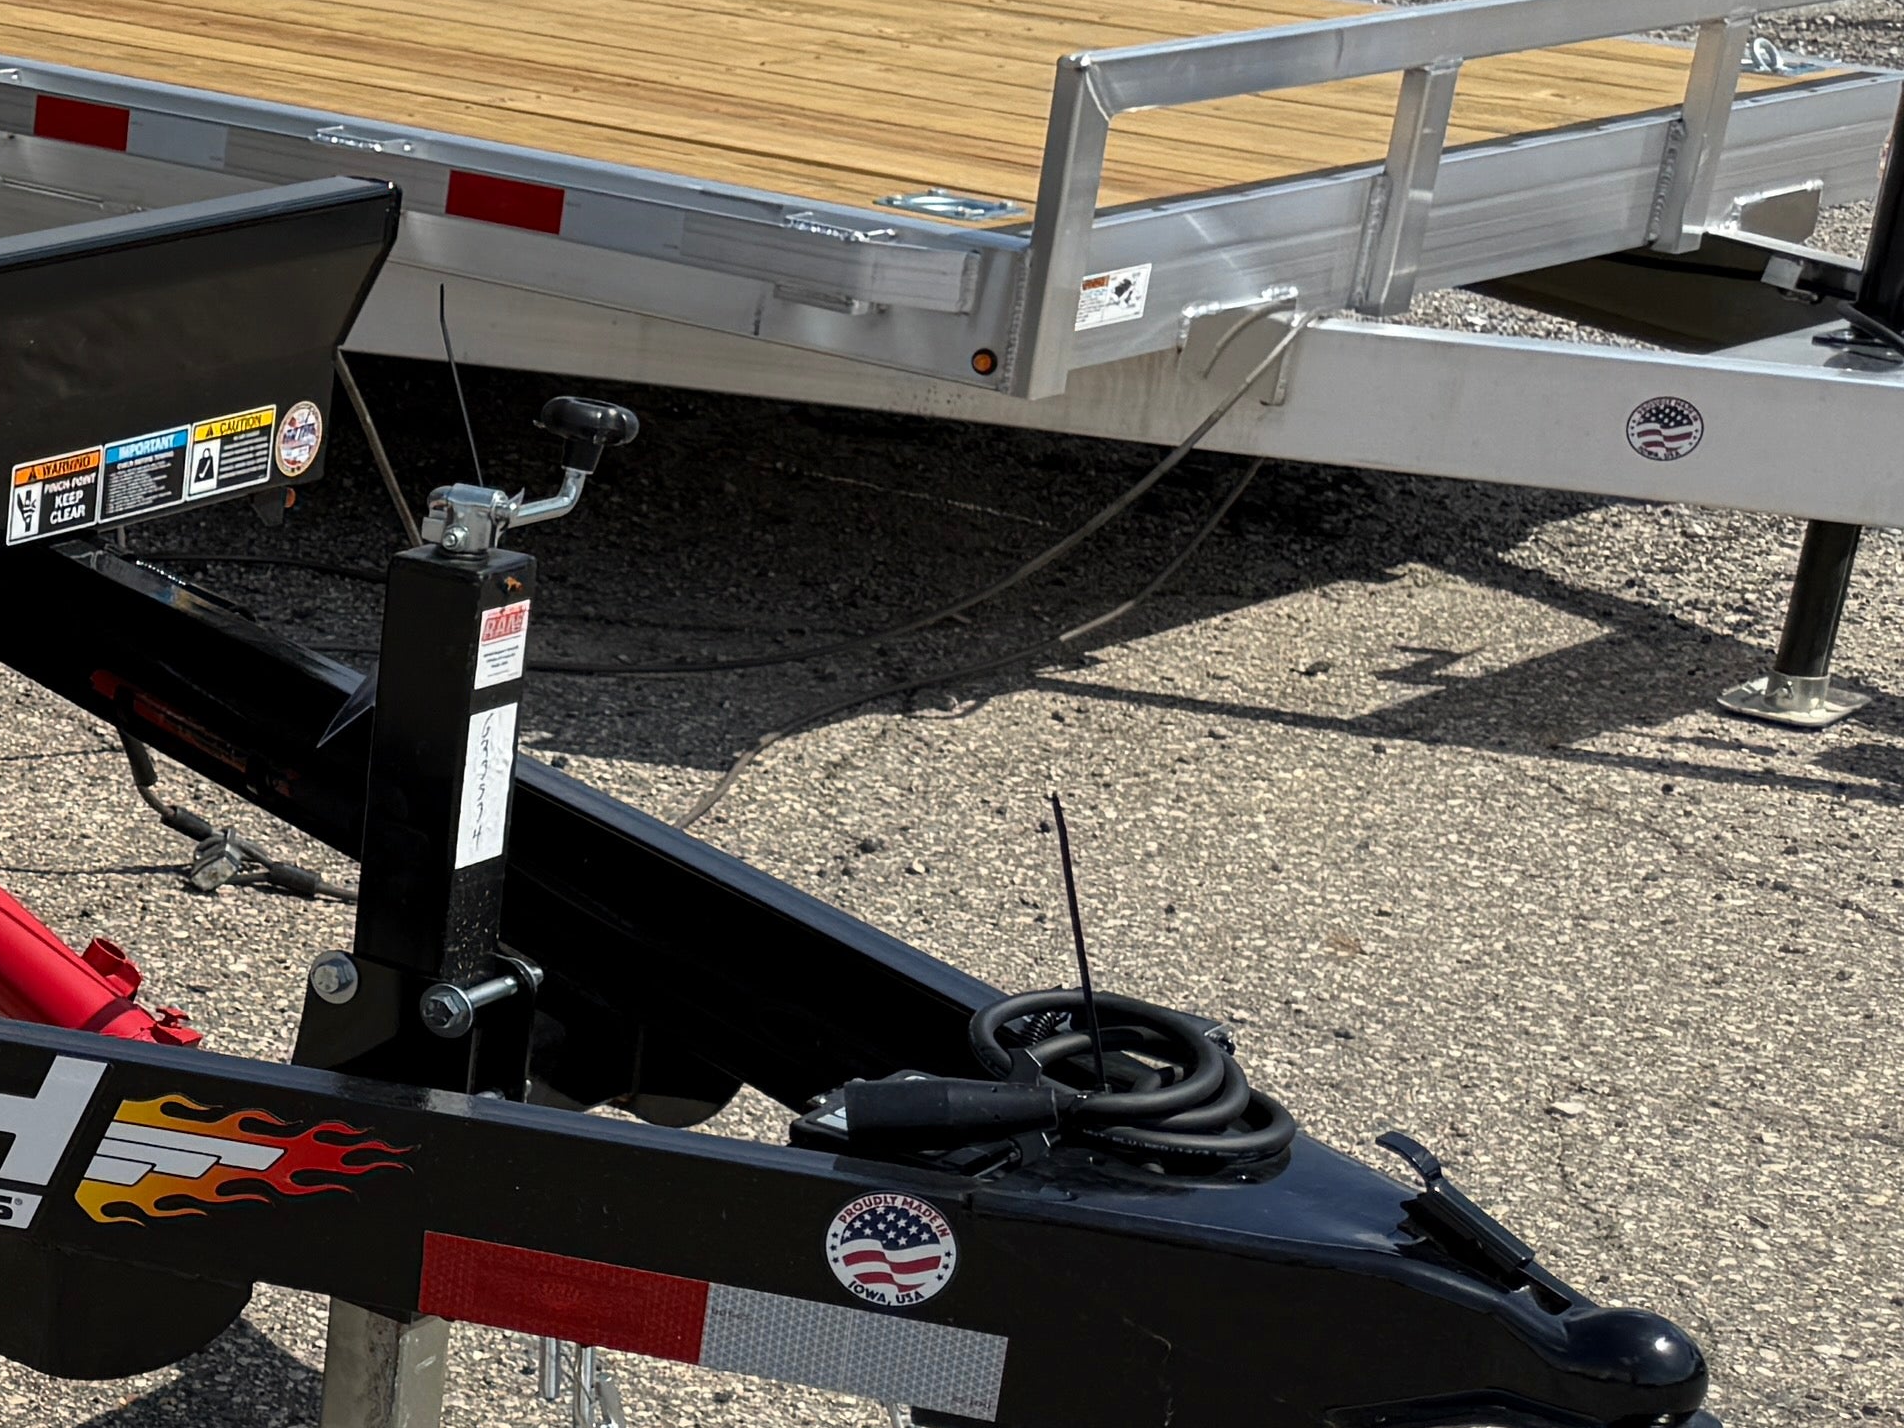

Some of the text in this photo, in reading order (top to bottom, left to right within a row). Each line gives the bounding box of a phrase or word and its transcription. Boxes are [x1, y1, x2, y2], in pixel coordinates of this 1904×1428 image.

[220, 414, 262, 434] CAUTION
[118, 434, 175, 460] IMPORTANT
[42, 455, 91, 477] WARNING
[55, 490, 83, 507] KEEP
[50, 505, 86, 524] CLEAR
[838, 1195, 951, 1238] PROUDLY MADE IN
[848, 1280, 925, 1306] IOWA, USA
